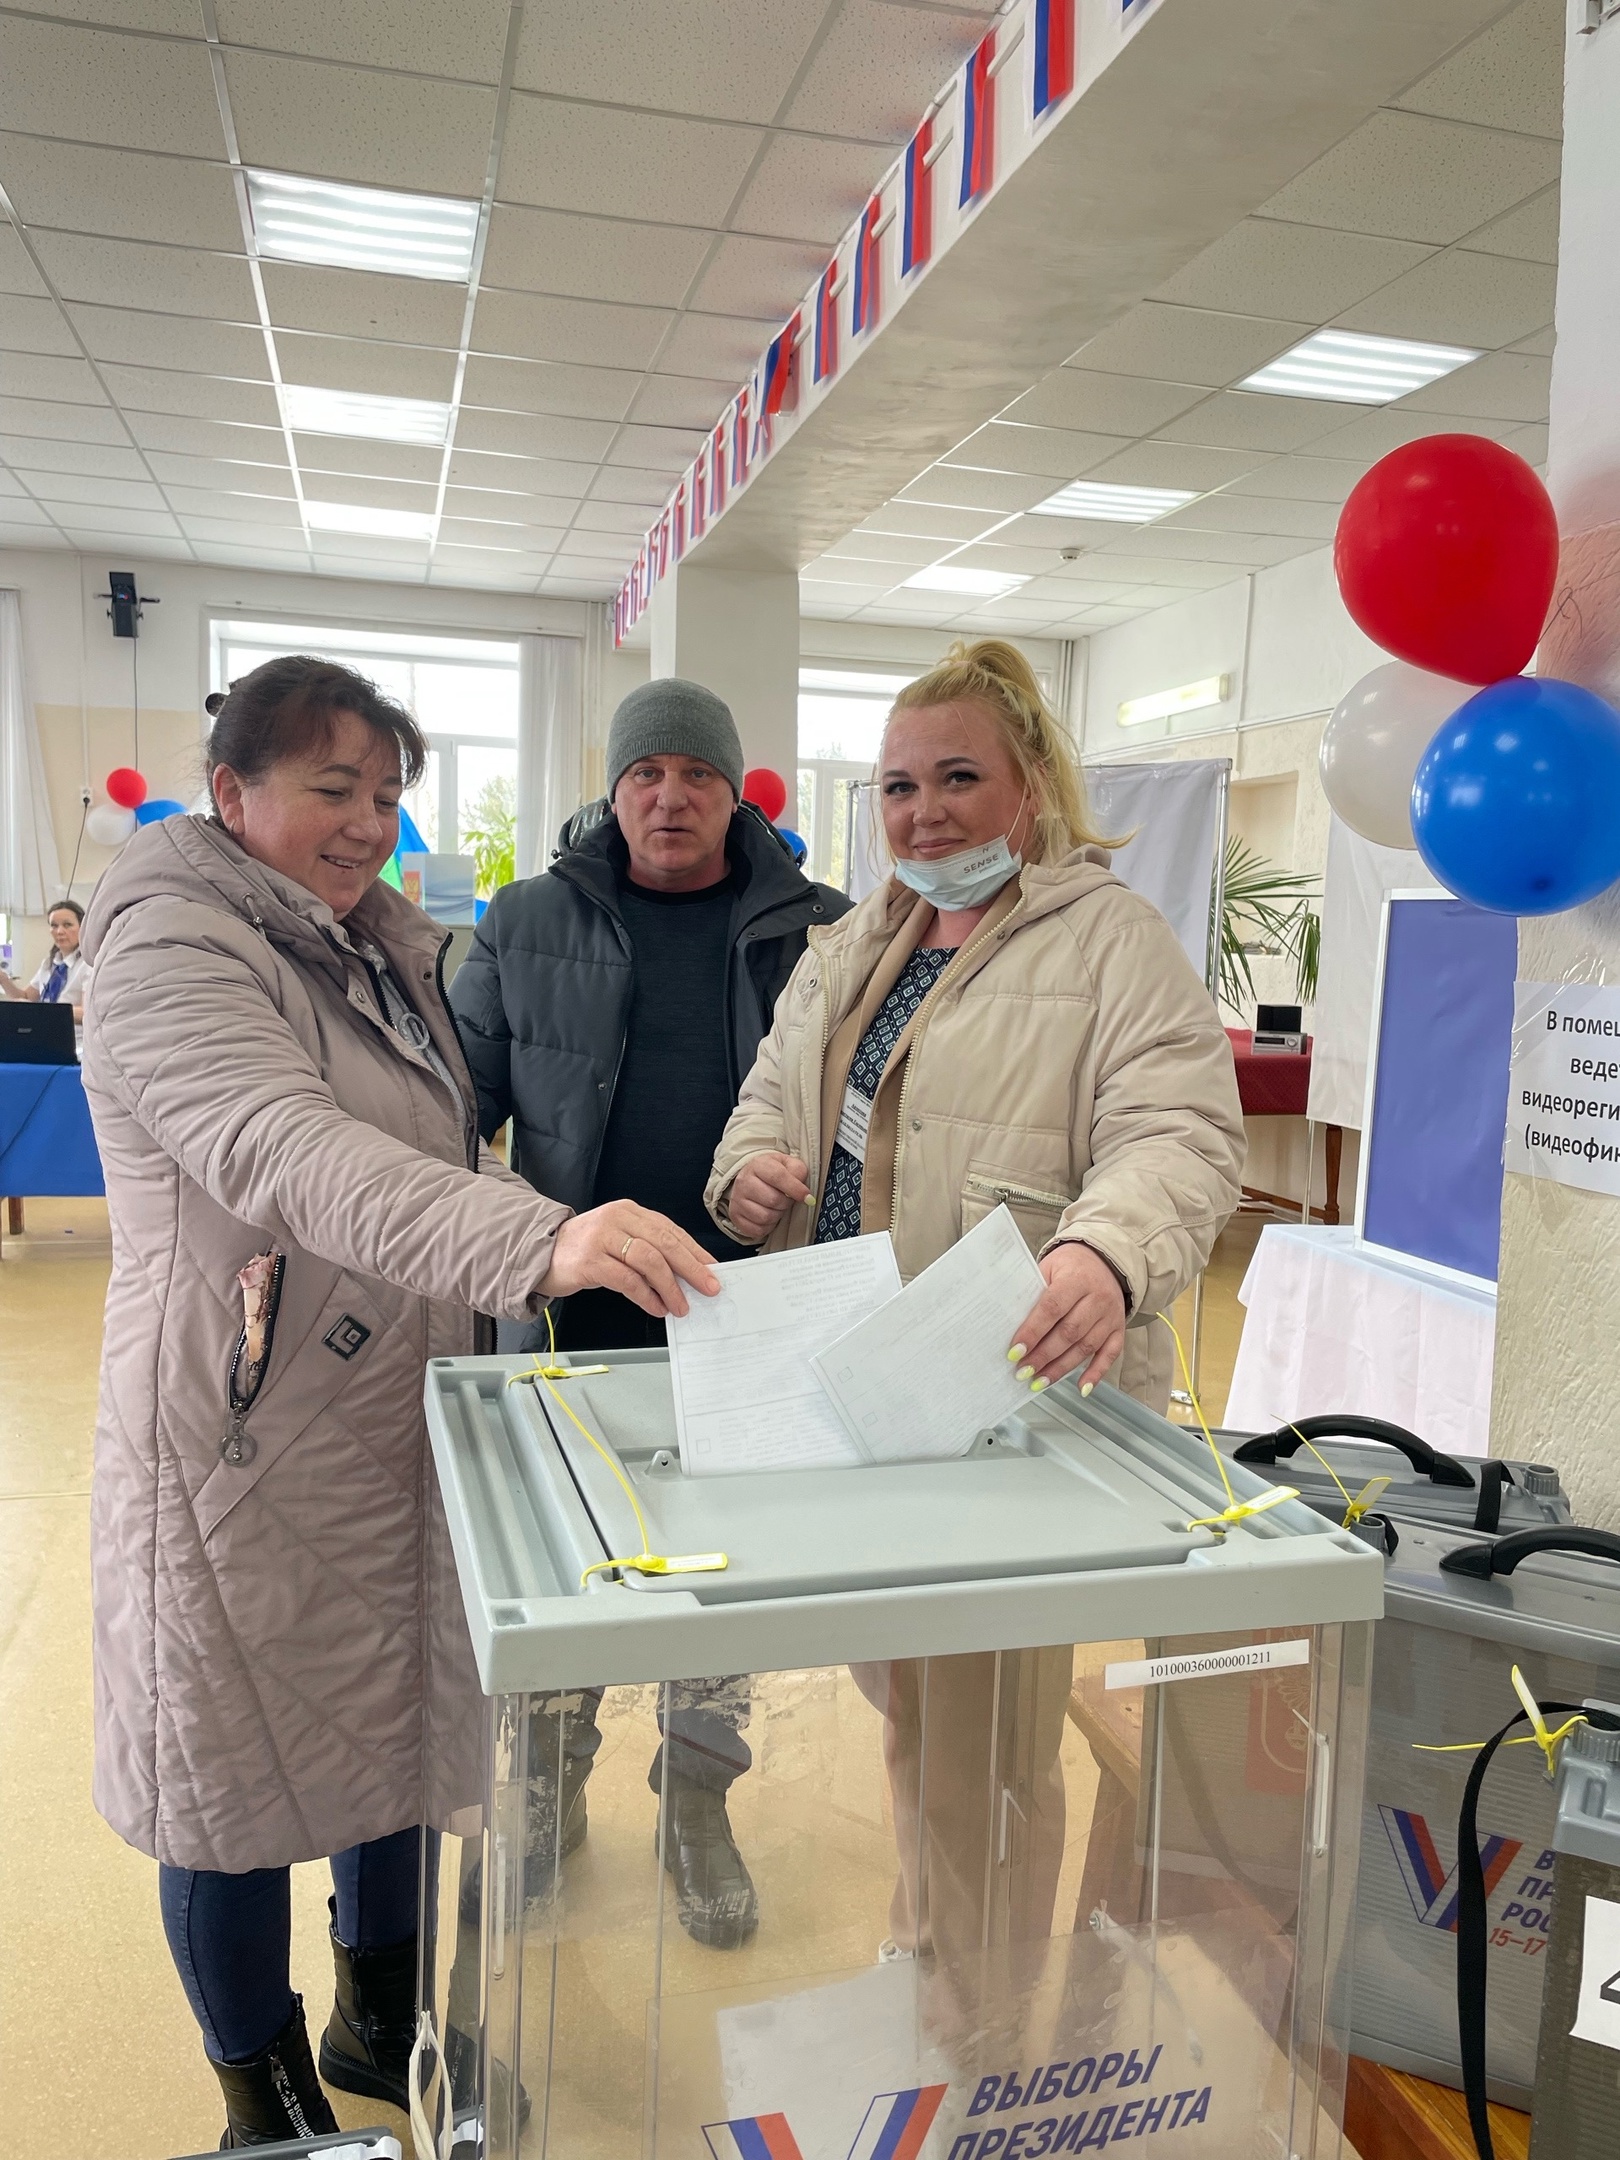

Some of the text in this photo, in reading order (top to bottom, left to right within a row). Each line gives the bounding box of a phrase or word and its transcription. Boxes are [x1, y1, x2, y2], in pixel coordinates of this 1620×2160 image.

[963, 853, 999, 873] SENSE
[1546, 1010, 1558, 1030] В
[1570, 1058, 1620, 1082] веде
[1149, 1651, 1271, 1677] 101000360000001211
[966, 2043, 1164, 2118] ВЫБОРЫ
[946, 2086, 1213, 2160] ПРЕЗИДЕНТА
